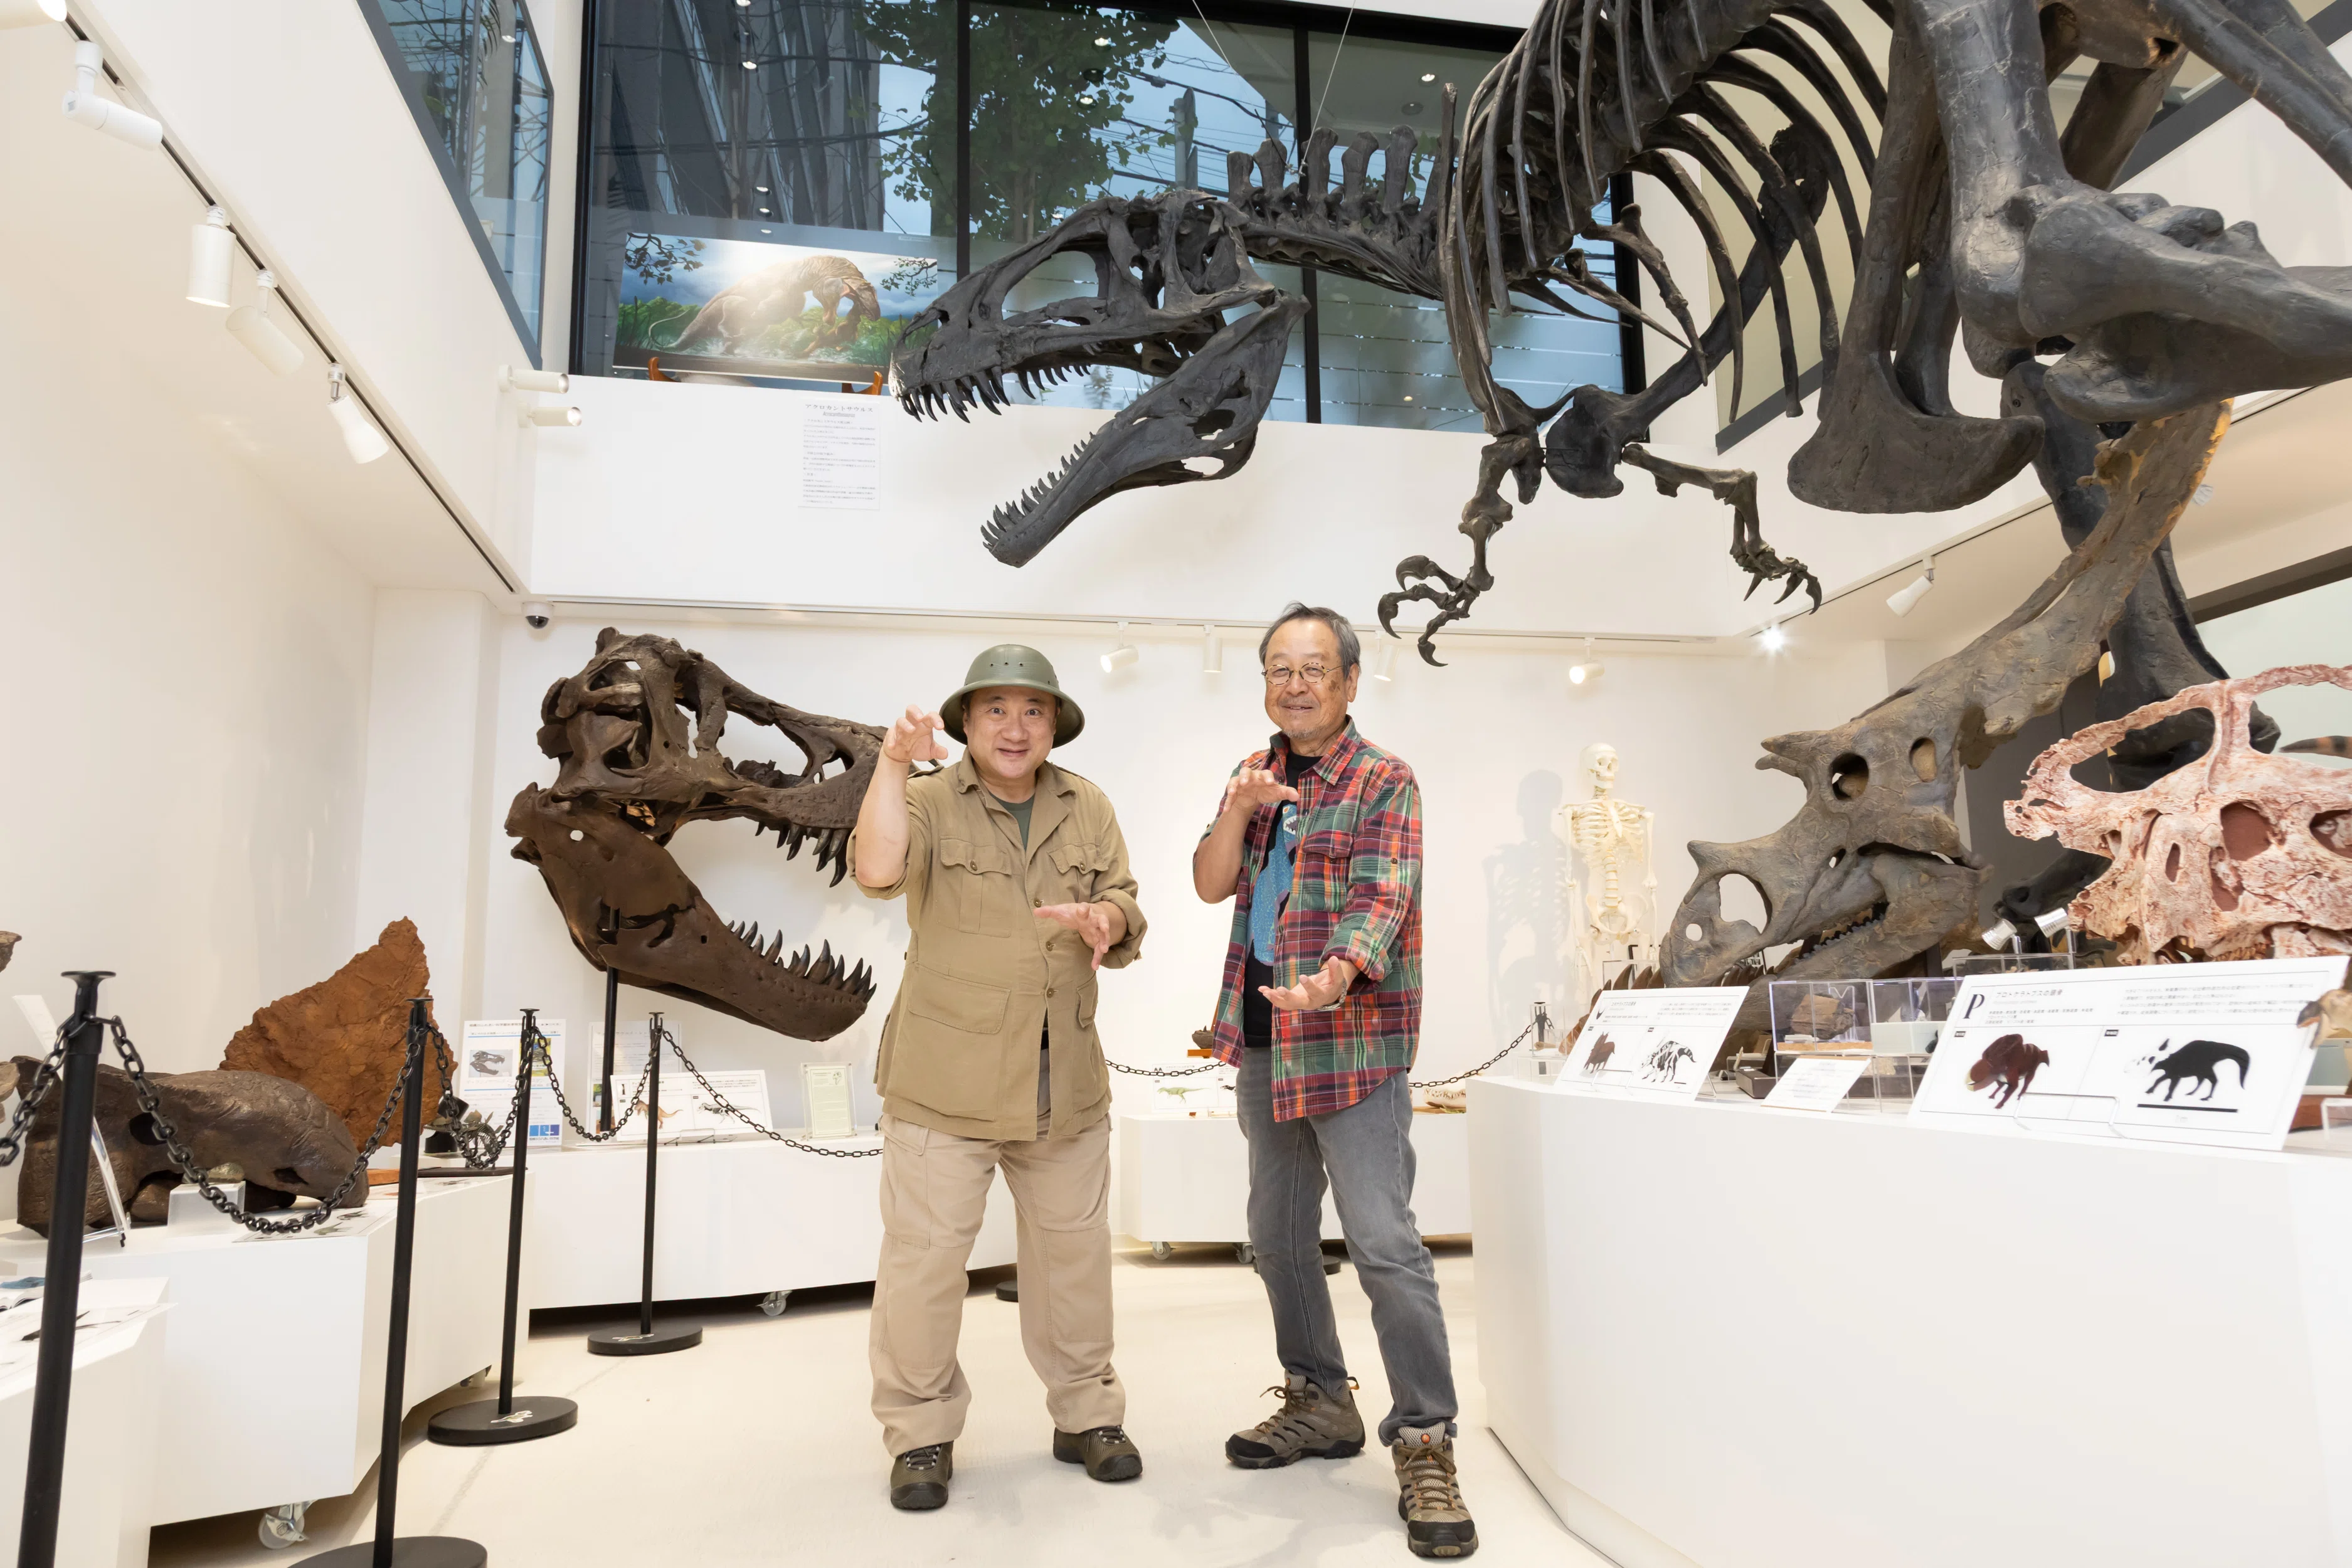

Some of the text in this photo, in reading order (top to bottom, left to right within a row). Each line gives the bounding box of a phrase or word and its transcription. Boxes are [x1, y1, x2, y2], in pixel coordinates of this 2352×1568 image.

[805, 404, 873, 412] アクロカントサウルス
[1963, 994, 1985, 1019] P
